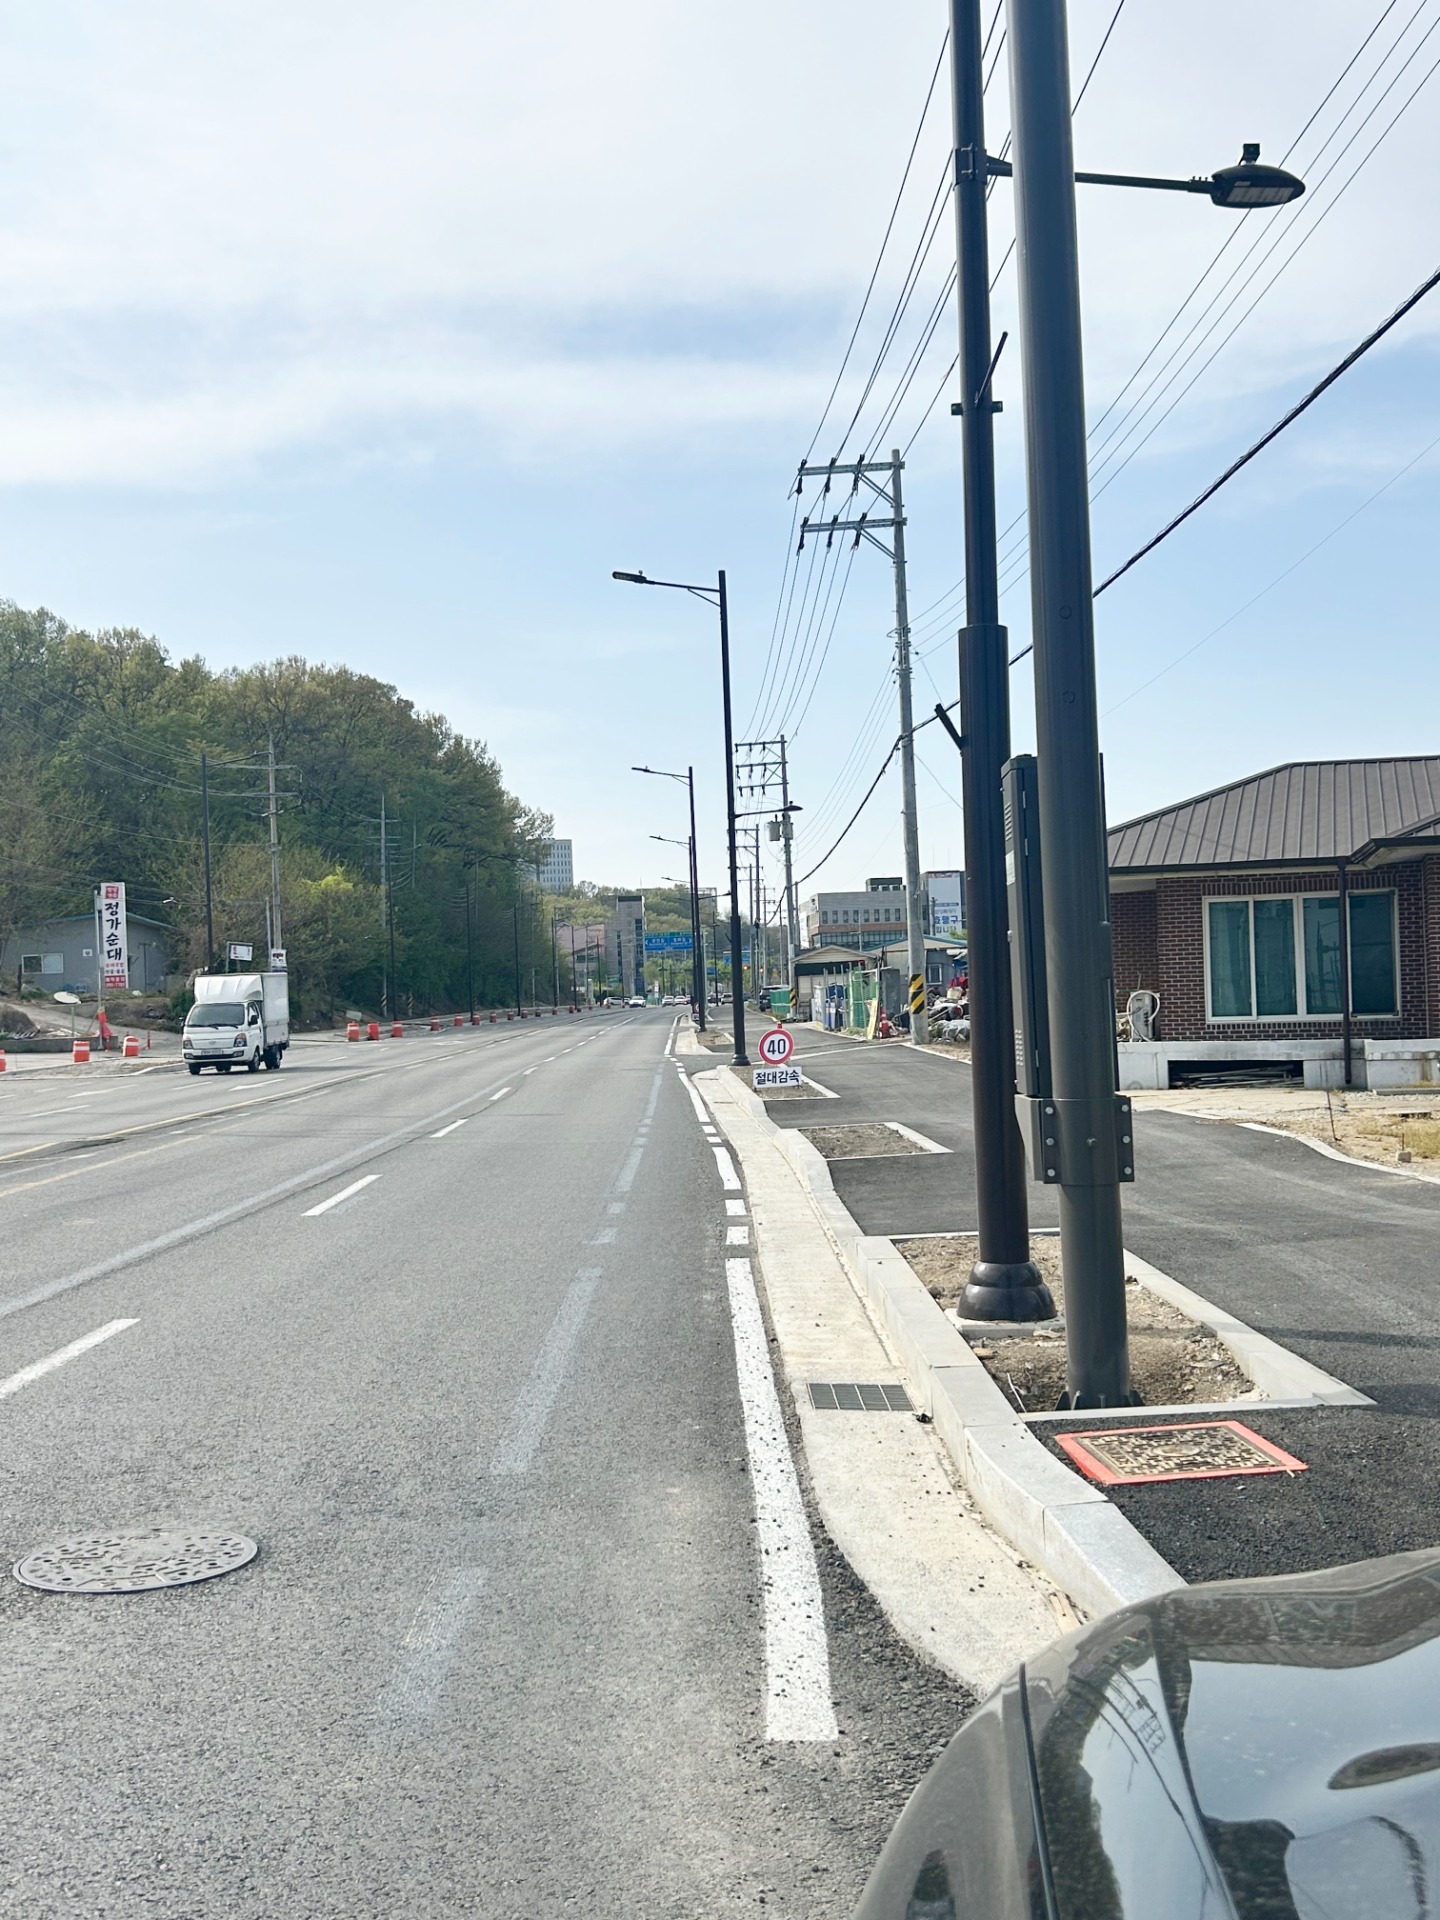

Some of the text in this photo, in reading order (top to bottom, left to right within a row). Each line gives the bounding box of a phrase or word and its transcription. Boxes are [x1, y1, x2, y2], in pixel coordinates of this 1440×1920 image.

[105, 902, 122, 961] 정가순대
[767, 1038, 786, 1055] 40
[755, 1069, 800, 1086] 절대감속
